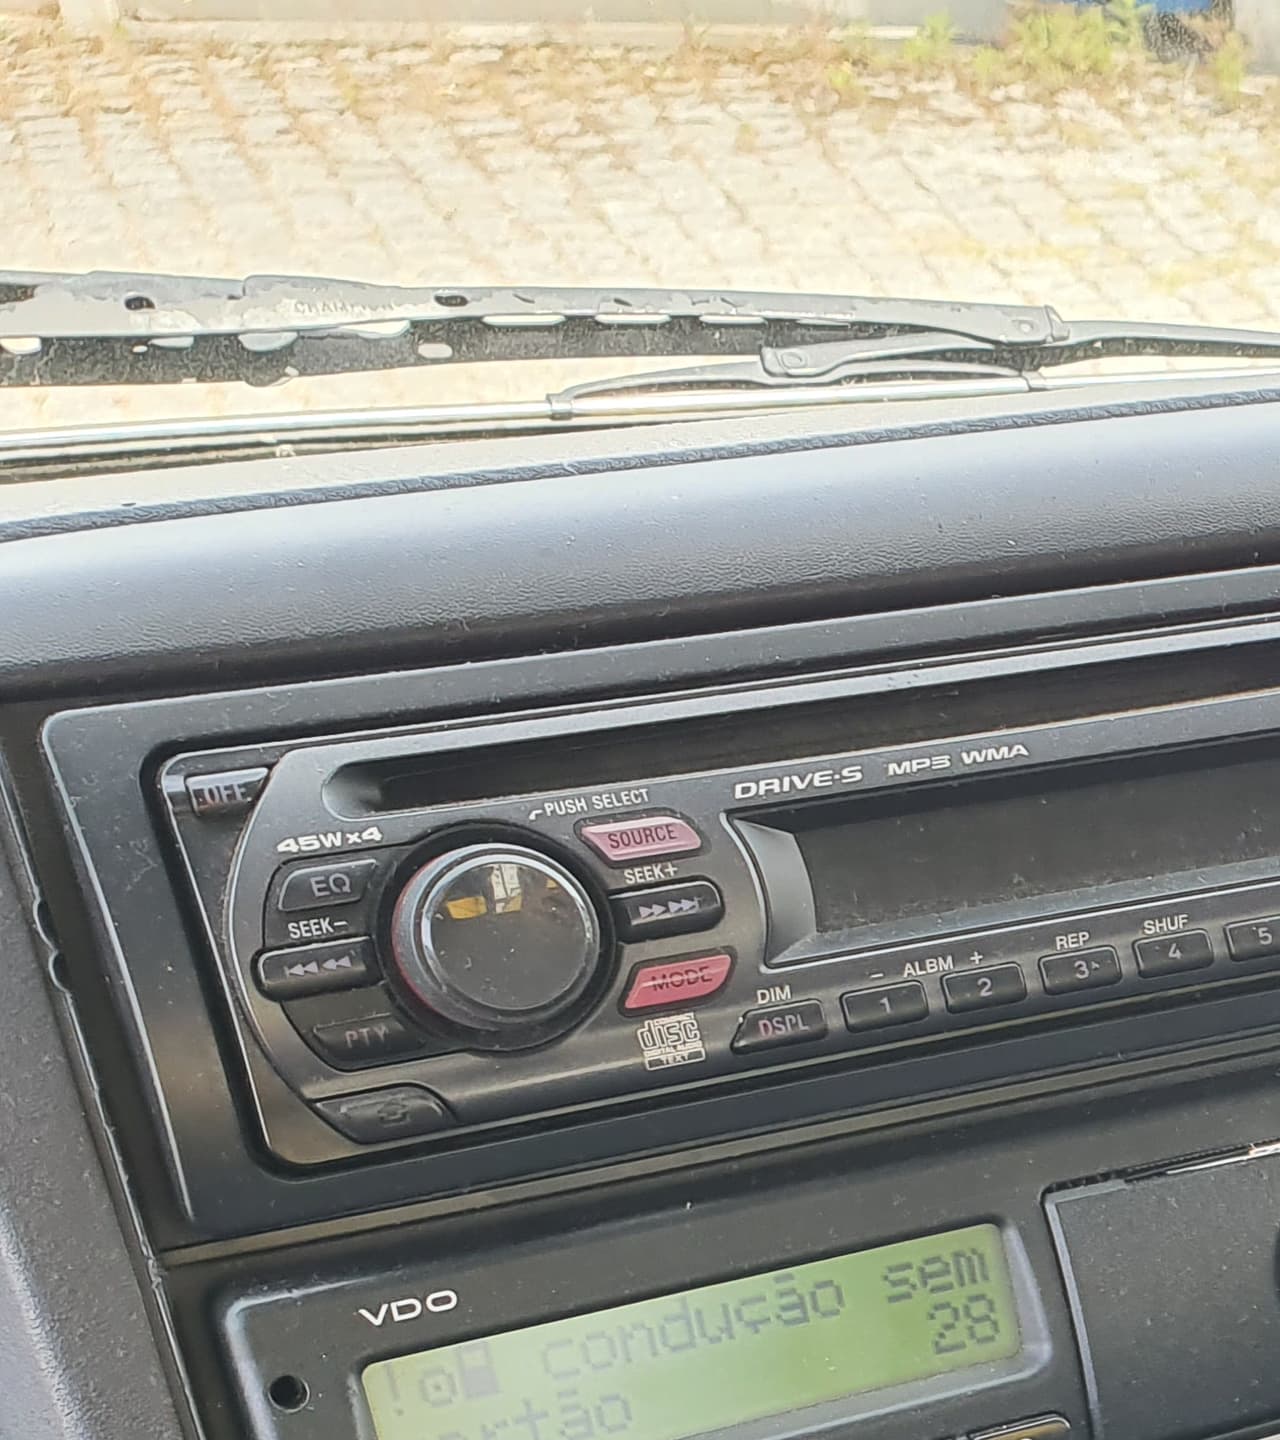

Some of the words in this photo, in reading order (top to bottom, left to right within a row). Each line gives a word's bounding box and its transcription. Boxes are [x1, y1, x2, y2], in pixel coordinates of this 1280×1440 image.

[887, 756, 950, 777] MP3
[961, 743, 1030, 765] WMA
[545, 798, 587, 818] PUSH
[592, 789, 650, 811] SELECT
[608, 824, 679, 847] SOURCE
[309, 873, 351, 897] EQ
[1143, 915, 1189, 935] SHUF
[1258, 927, 1273, 945] 5
[1055, 932, 1090, 951] REP
[1168, 943, 1182, 960] 4
[650, 965, 714, 992] MODE
[903, 955, 954, 979] ALBM
[1073, 961, 1090, 979] 3
[757, 985, 791, 1004] DIM
[977, 978, 993, 997] 2
[881, 997, 891, 1013] 1
[343, 1025, 390, 1048] PTY
[757, 1013, 809, 1037] DSPL
[357, 1290, 458, 1327] VDO
[541, 1272, 847, 1381] condução
[882, 1247, 992, 1304] sem
[928, 1294, 1000, 1356] 28
